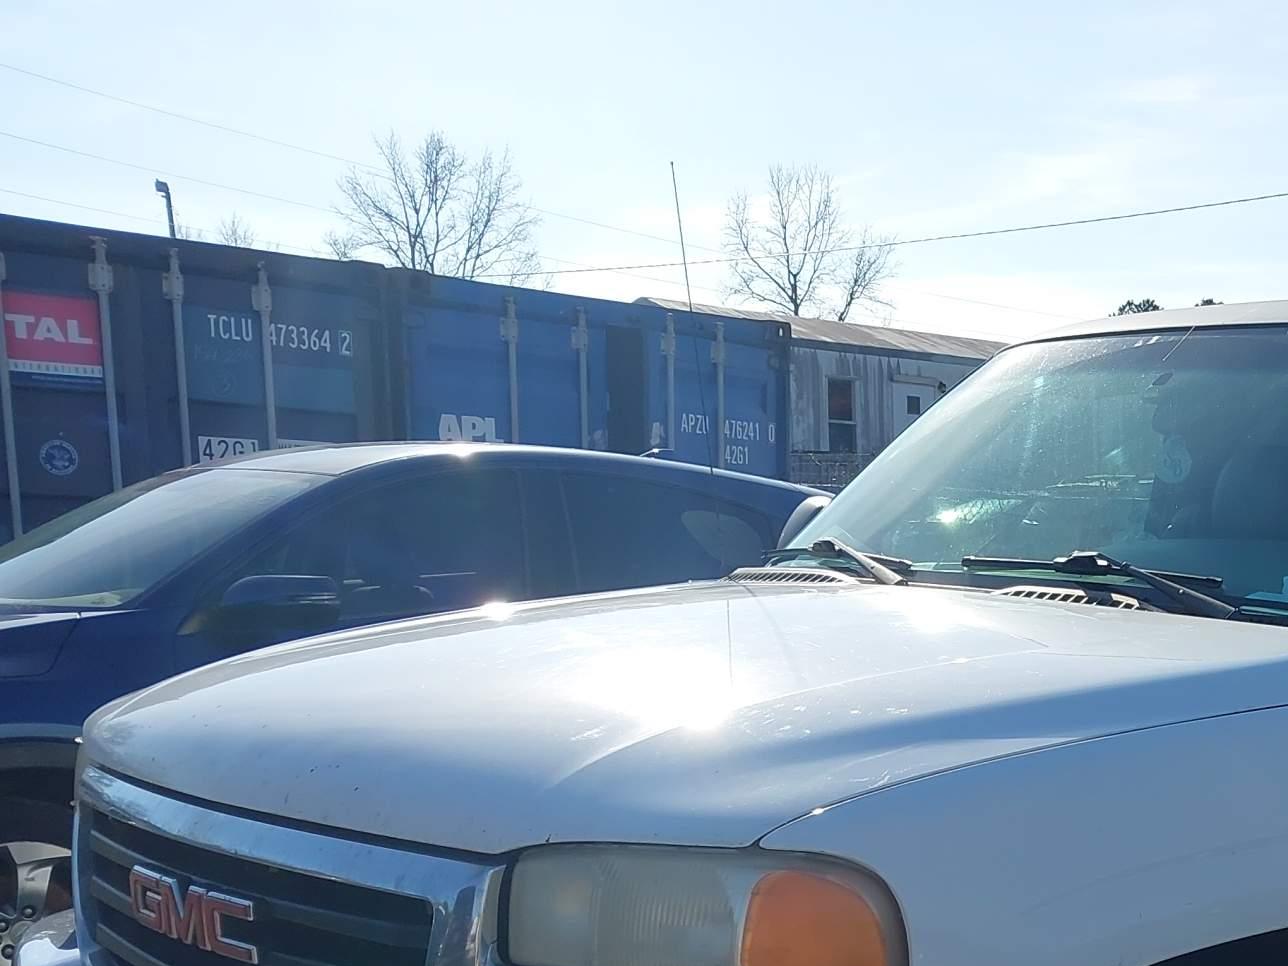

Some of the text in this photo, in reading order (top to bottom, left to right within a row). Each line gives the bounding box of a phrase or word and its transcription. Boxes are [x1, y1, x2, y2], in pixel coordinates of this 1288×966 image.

[4, 312, 94, 345] TAL
[207, 314, 351, 356] TCLU 473364 2
[438, 413, 505, 443] APL
[681, 412, 710, 435] APZU
[724, 419, 760, 441] 476241
[129, 864, 259, 965] GMC
